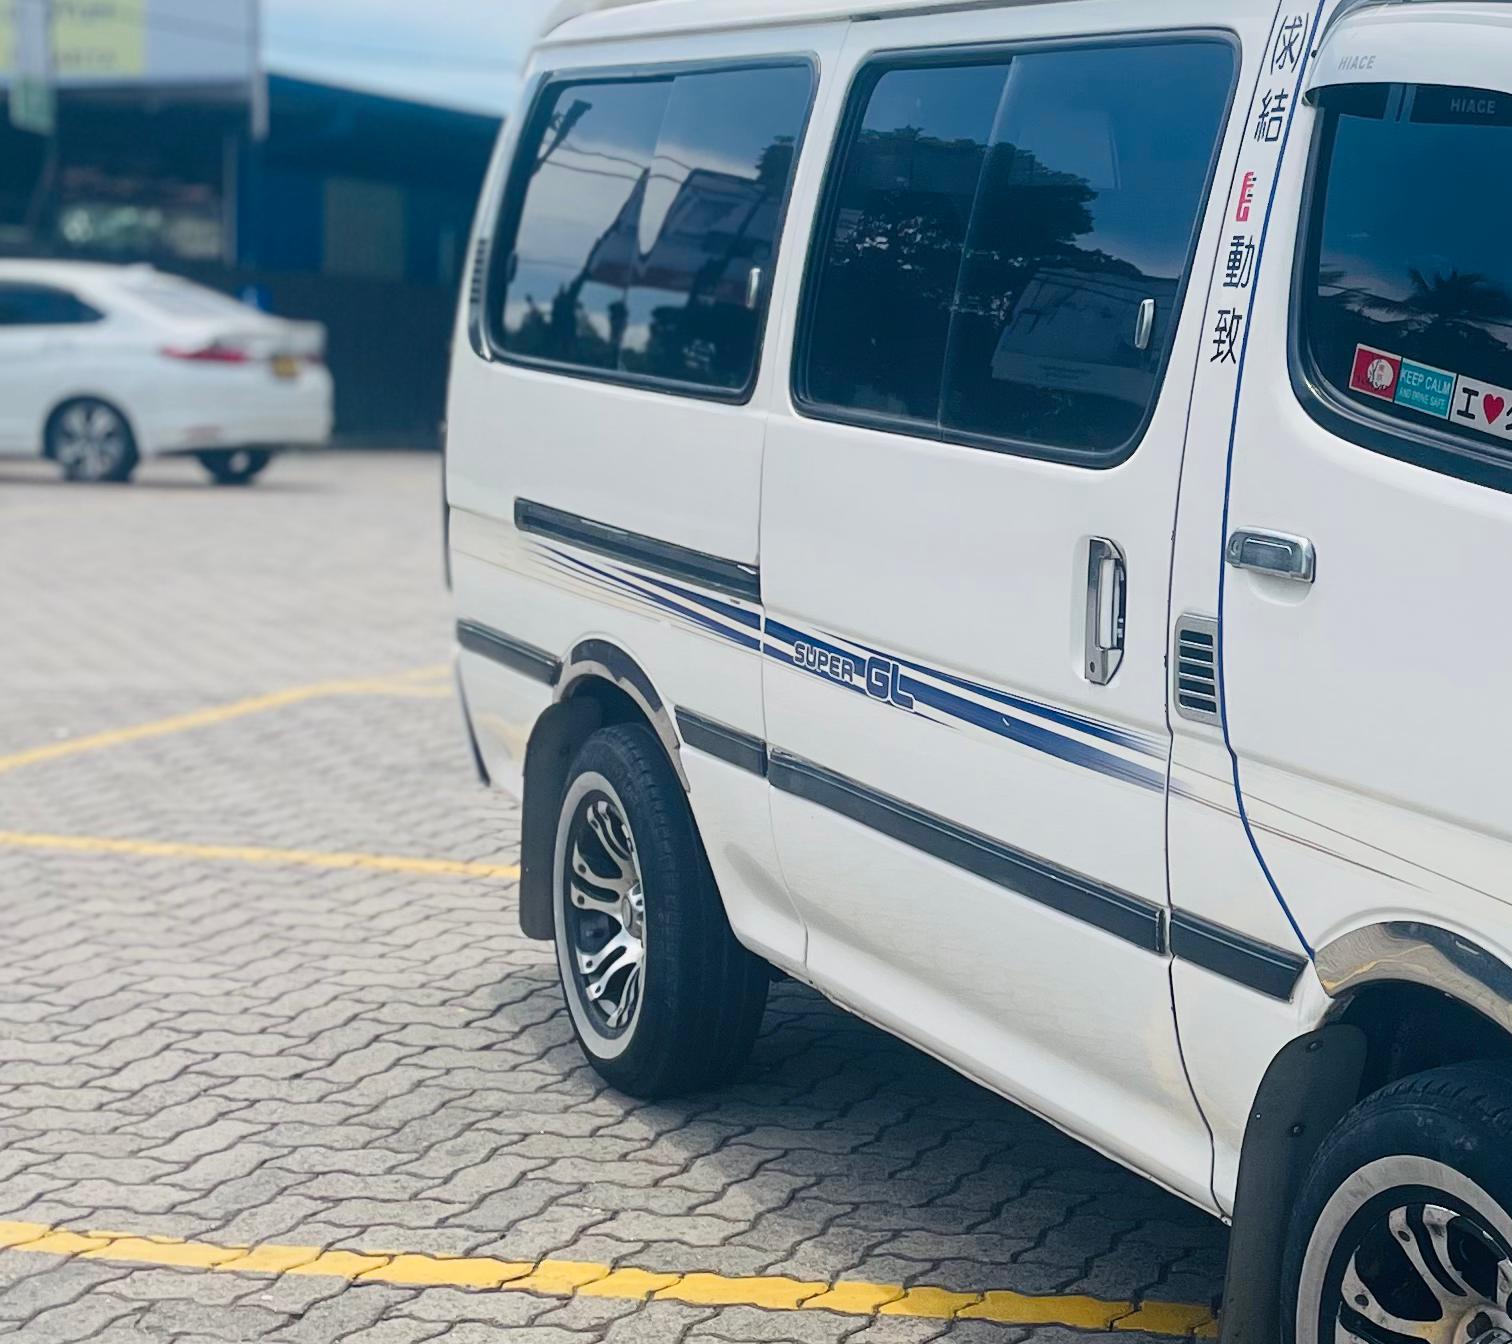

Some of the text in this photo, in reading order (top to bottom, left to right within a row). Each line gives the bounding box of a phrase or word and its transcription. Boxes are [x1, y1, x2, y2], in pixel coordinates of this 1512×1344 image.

[1338, 55, 1376, 70] HIACE
[1450, 98, 1496, 114] HIACE
[1399, 368, 1425, 386] KEEP
[1425, 376, 1451, 395] CALM
[793, 641, 915, 712] SUPER GL
